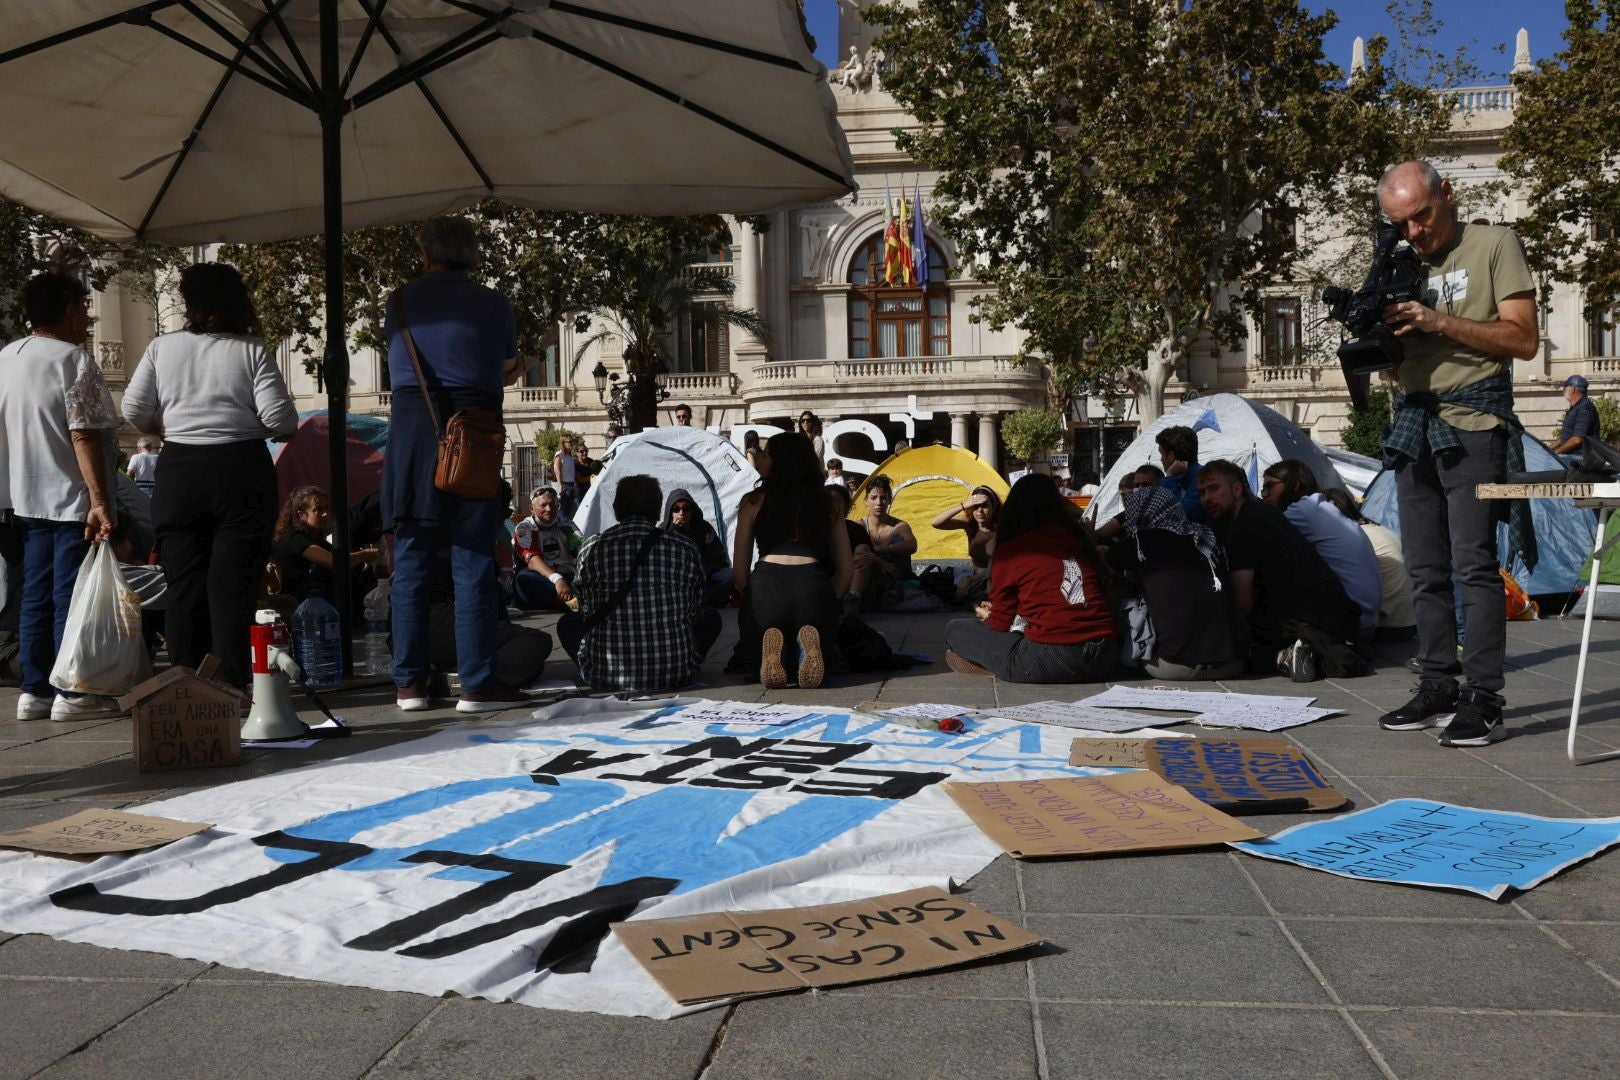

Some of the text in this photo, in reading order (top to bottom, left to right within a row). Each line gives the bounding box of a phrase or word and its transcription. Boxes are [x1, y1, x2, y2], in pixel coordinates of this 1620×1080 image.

[175, 687, 193, 699] EL
[147, 702, 236, 720] TEU AIRBNB
[150, 721, 220, 741] ERA UNA
[156, 738, 224, 766] CASA
[662, 736, 874, 766] EN
[1199, 741, 1247, 775] NOSTRES
[1211, 775, 1250, 787] LES
[1249, 751, 1308, 793] VIDES!!
[1035, 795, 1080, 812] BON
[1134, 822, 1179, 835] LA
[1181, 815, 1228, 833] DEL
[1332, 820, 1531, 878] DEL ALQUILER
[1451, 839, 1575, 877] BONOS
[50, 828, 681, 974] VLC
[650, 897, 966, 961] SENSE GENT
[738, 924, 1005, 974] NI CASA
